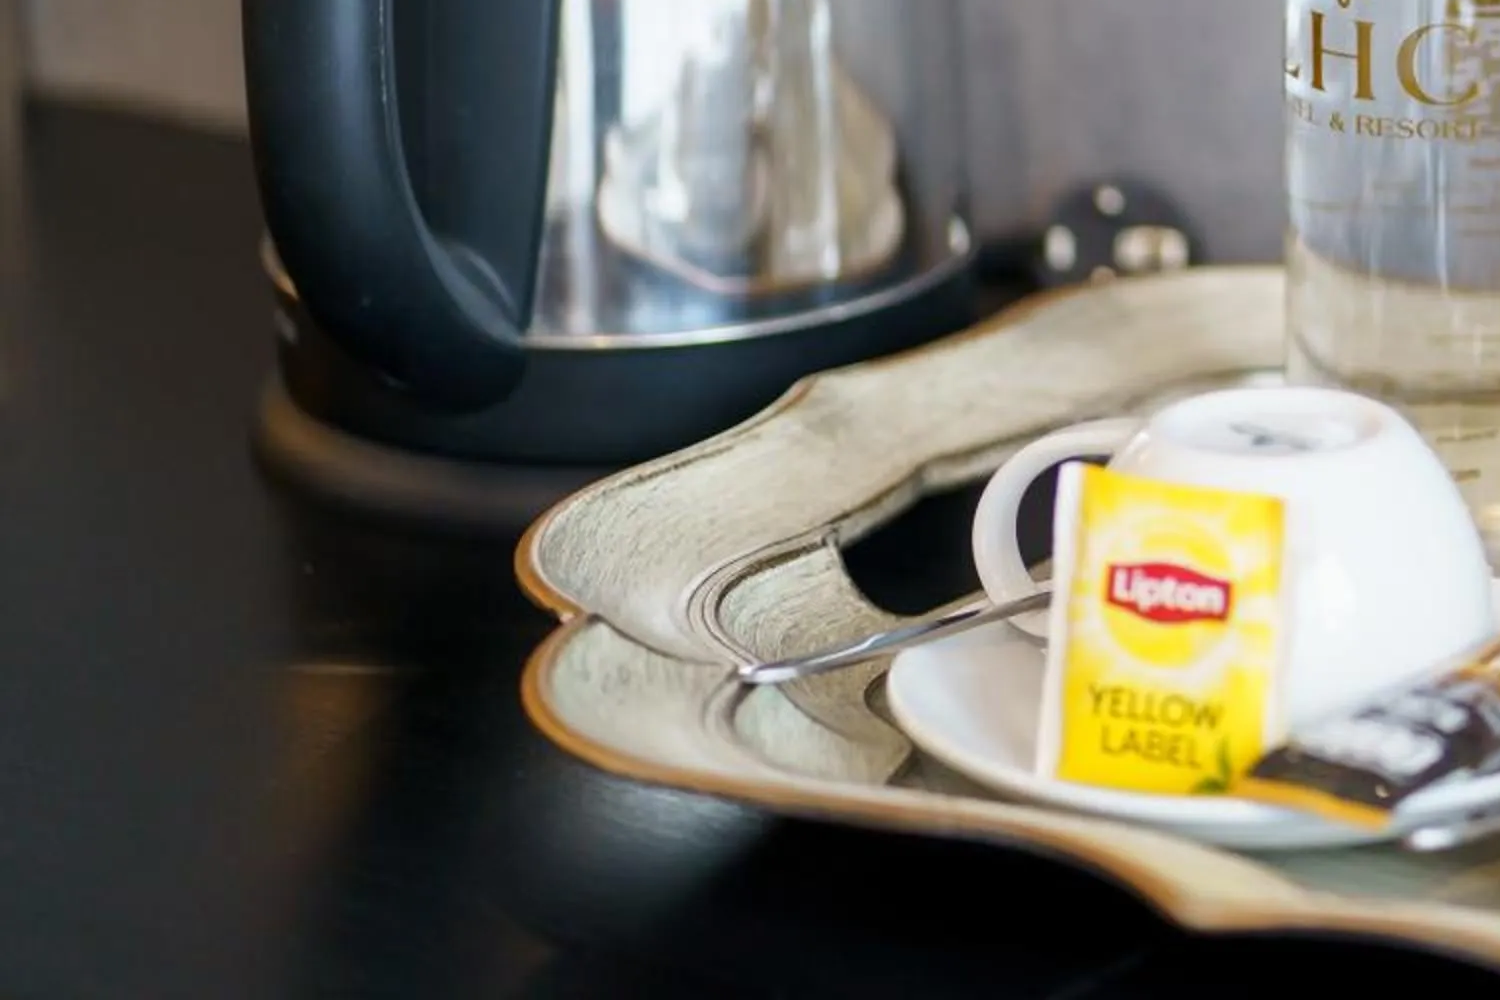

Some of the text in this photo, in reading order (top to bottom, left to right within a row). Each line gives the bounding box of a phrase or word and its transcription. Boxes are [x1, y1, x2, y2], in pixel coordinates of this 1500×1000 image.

[1329, 110, 1346, 134] &
[1355, 114, 1480, 143] RESORT
[1112, 567, 1227, 615] Lipton
[1088, 683, 1225, 731] YELLOW
[1101, 725, 1201, 771] LABEL
